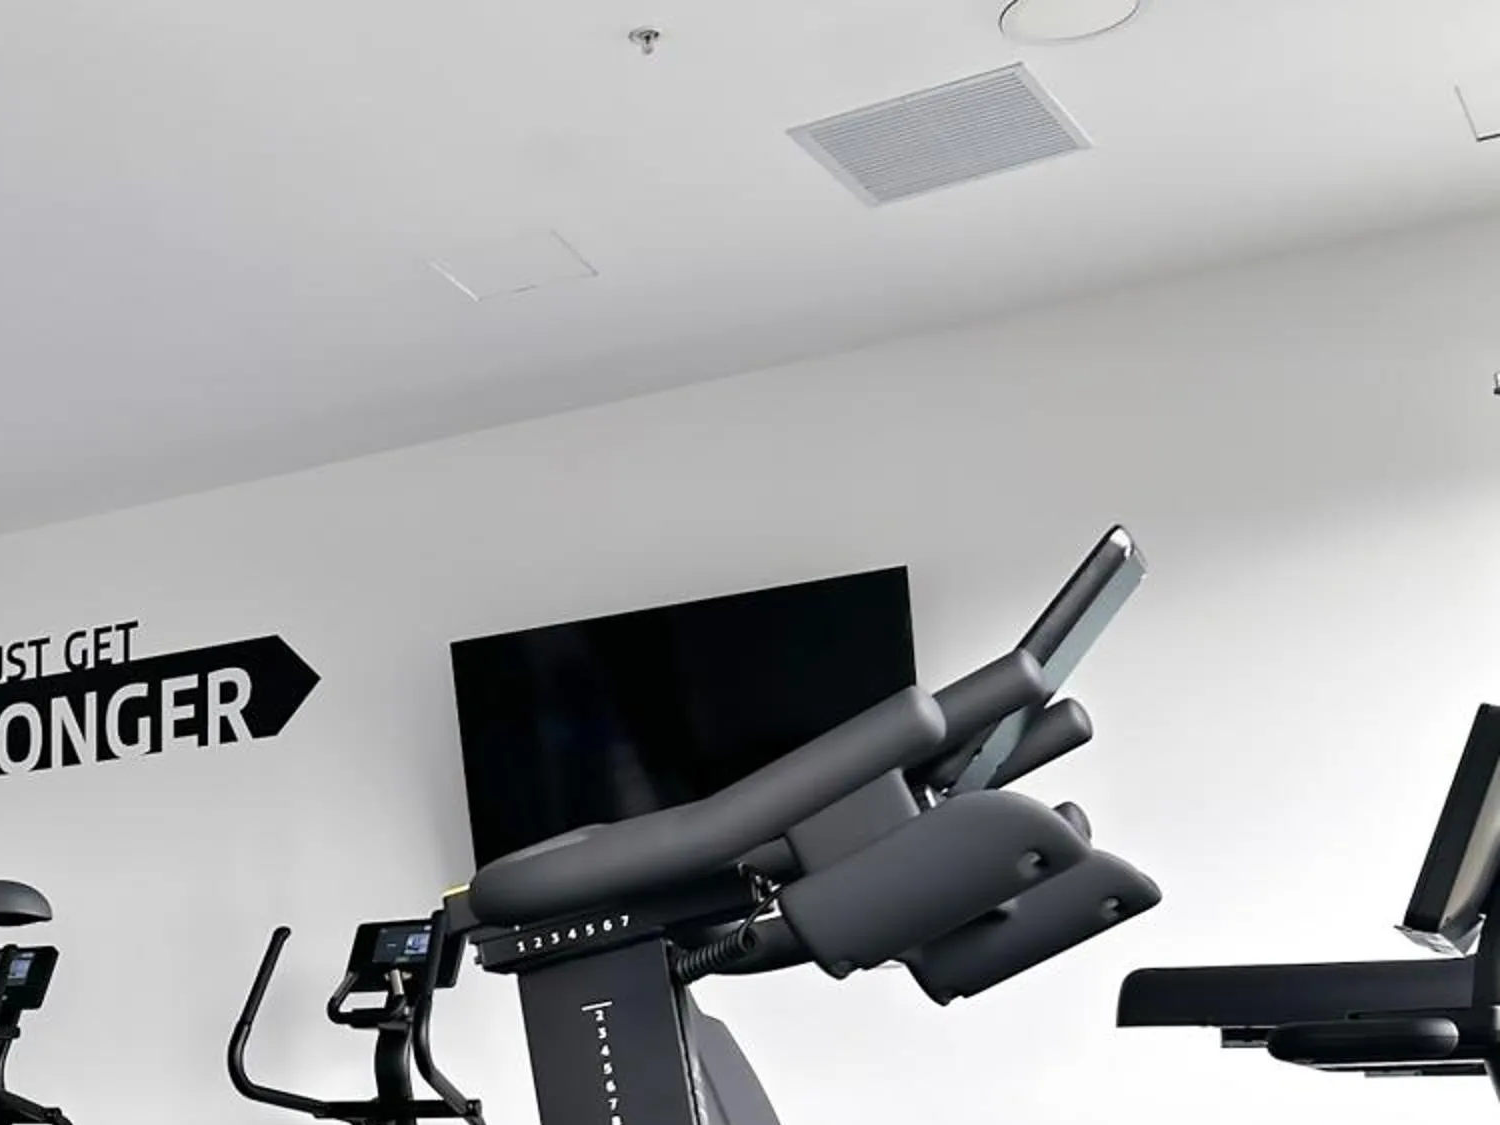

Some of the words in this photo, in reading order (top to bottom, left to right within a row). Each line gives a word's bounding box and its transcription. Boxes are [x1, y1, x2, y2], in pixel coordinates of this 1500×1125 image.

[64, 620, 139, 672] GET
[517, 941, 525, 953] 1
[533, 936, 543, 949] 2
[551, 932, 560, 944] 3
[567, 928, 577, 939] 4
[585, 923, 595, 937] 5
[603, 919, 613, 931] 6
[620, 915, 629, 927] 7
[600, 1044, 610, 1057] 4
[603, 1062, 613, 1075] 5
[605, 1079, 617, 1093] 6
[608, 1097, 618, 1111] 7
